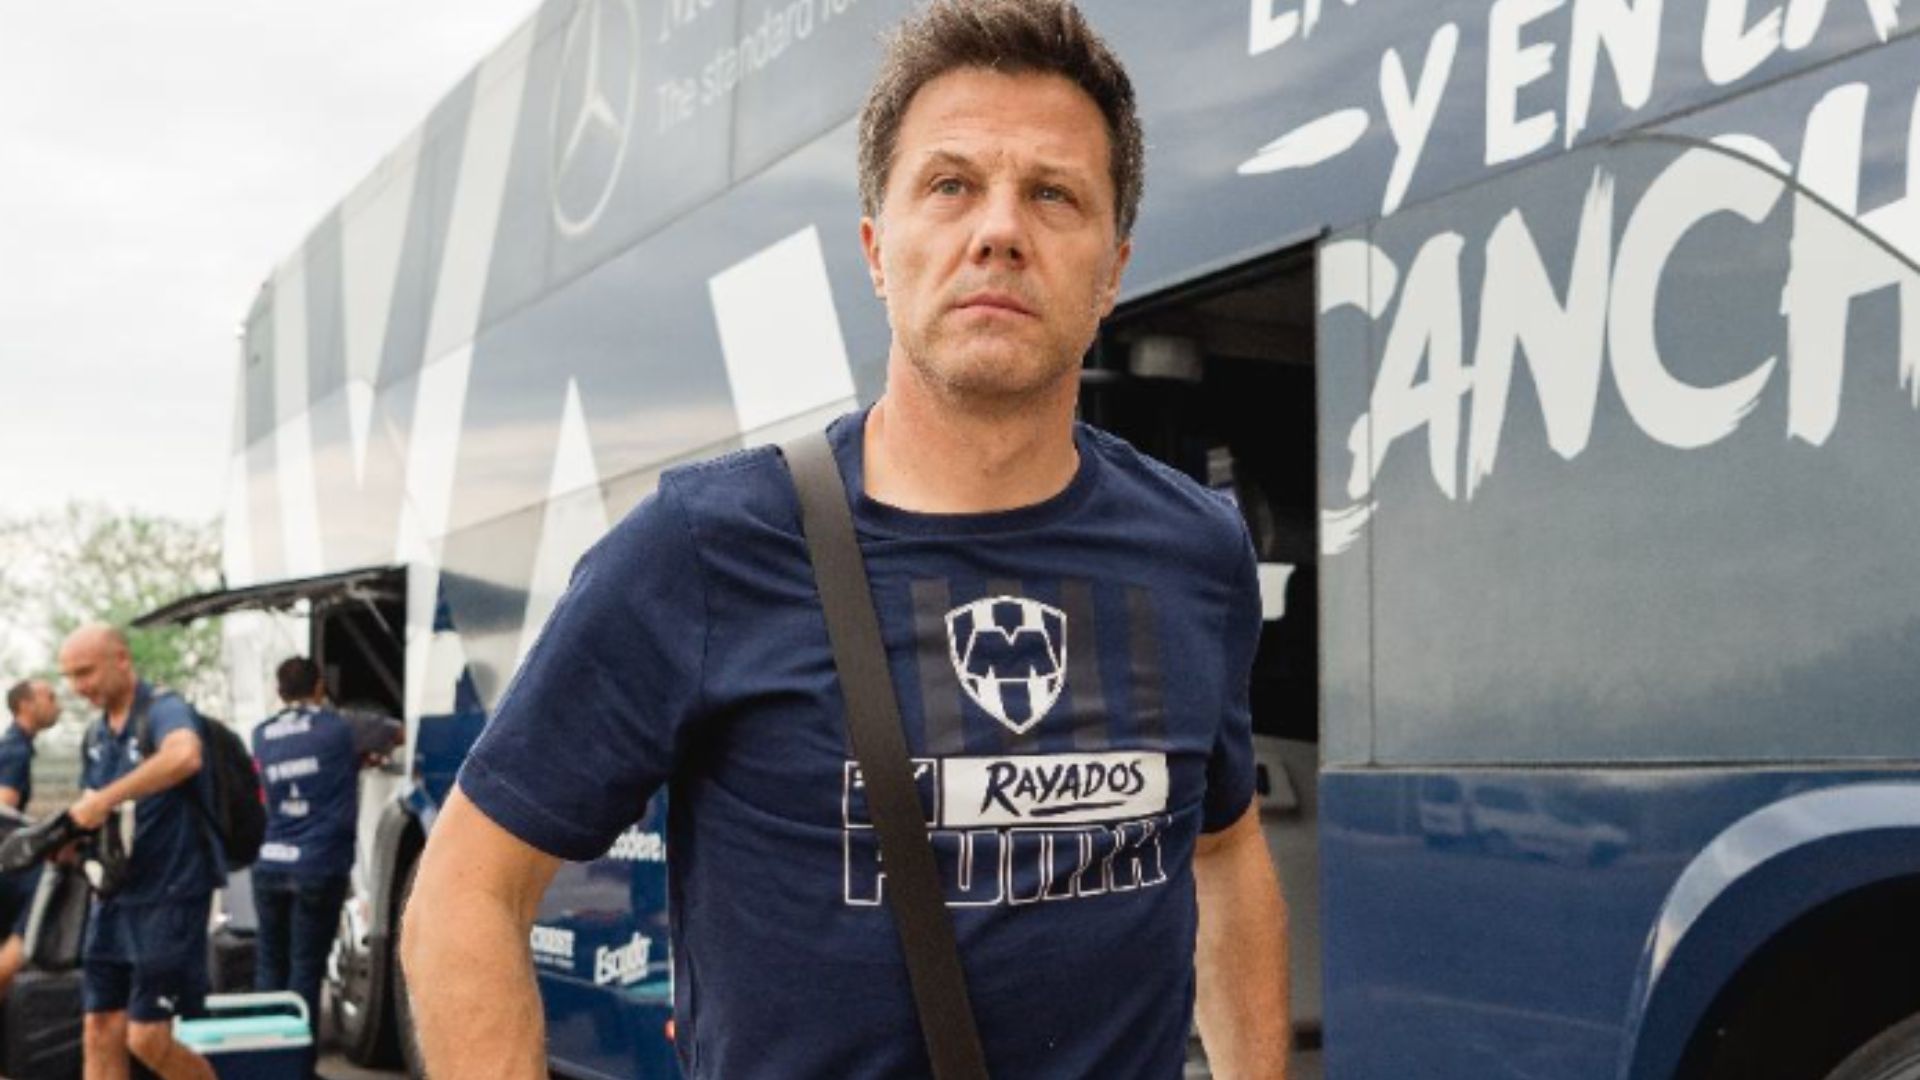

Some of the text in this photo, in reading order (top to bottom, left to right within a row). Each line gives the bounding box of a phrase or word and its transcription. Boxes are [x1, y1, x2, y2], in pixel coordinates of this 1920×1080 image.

[657, 77, 698, 135] The
[701, 0, 813, 106] standard
[1486, 0, 1662, 166] EN
